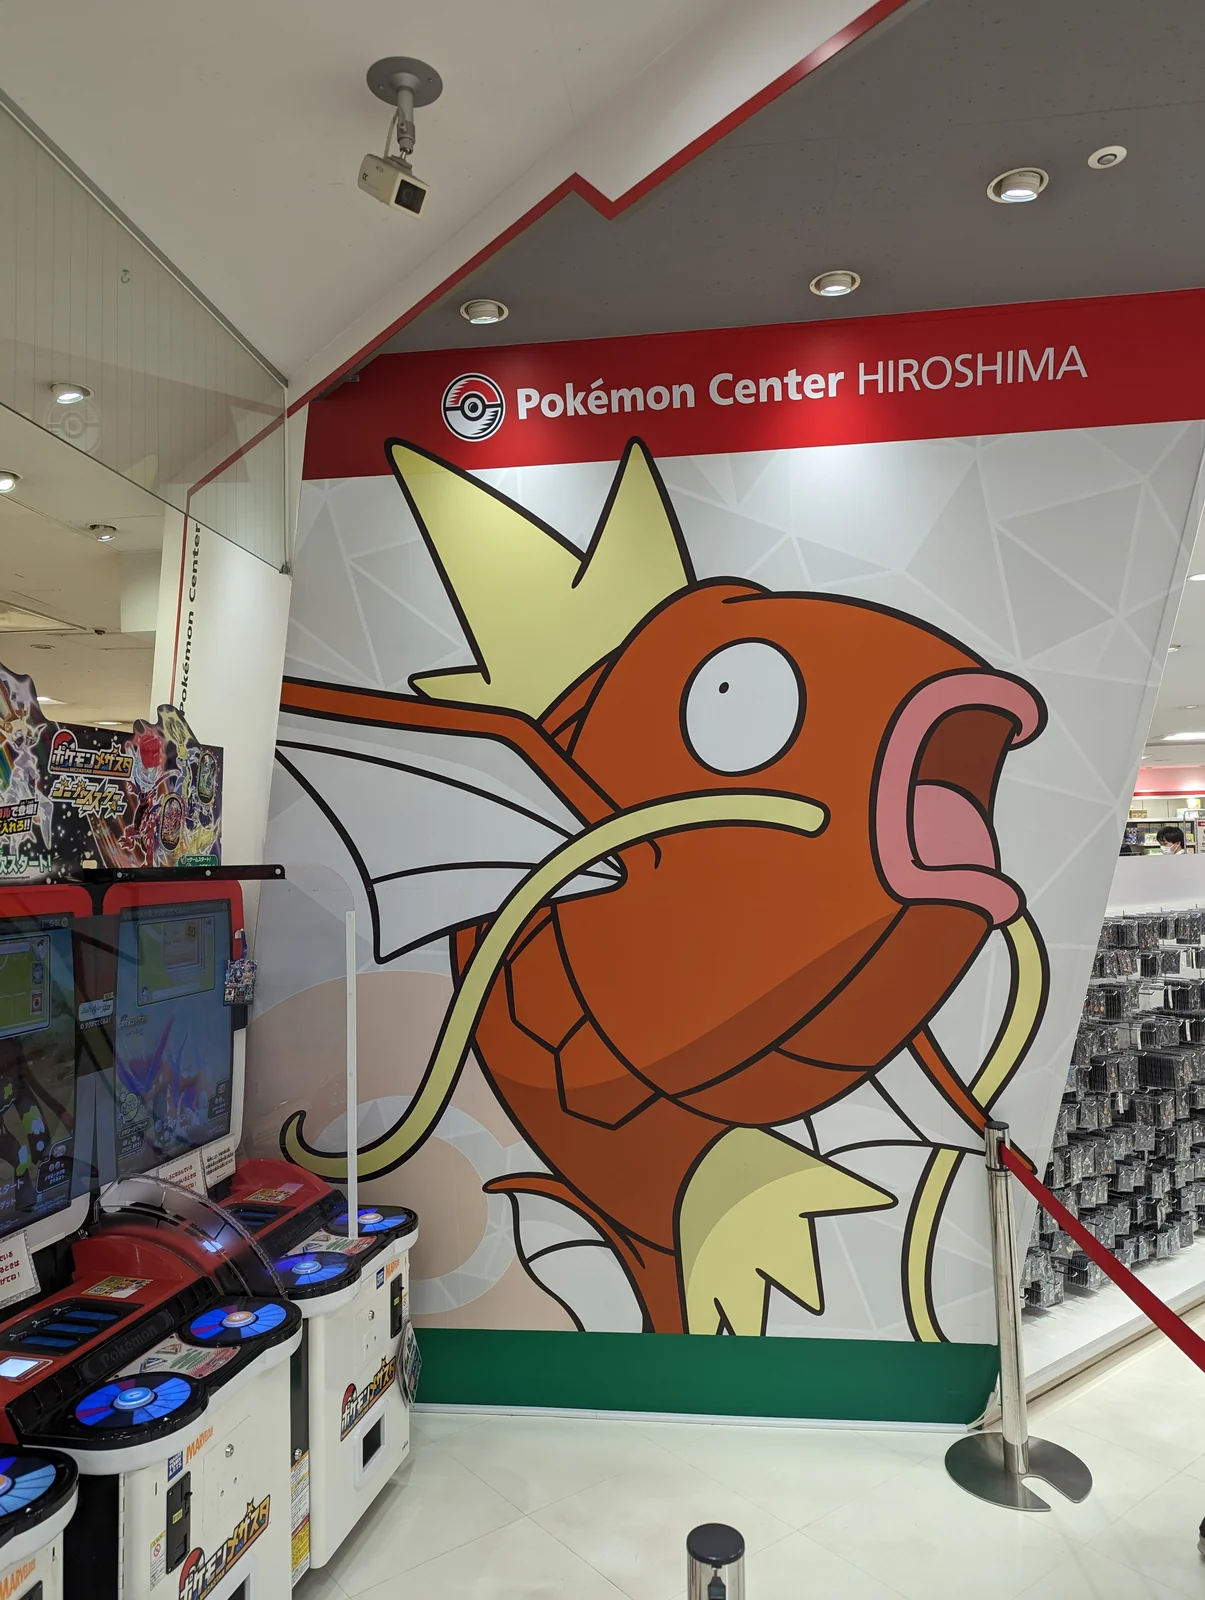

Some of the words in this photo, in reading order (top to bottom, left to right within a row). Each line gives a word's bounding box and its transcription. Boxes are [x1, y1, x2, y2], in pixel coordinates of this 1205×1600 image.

[517, 377, 695, 420] Pokémon
[709, 368, 844, 406] Center
[858, 345, 1089, 396] HIROSHIMA
[179, 611, 194, 716] Pokémon
[189, 523, 200, 603] Center
